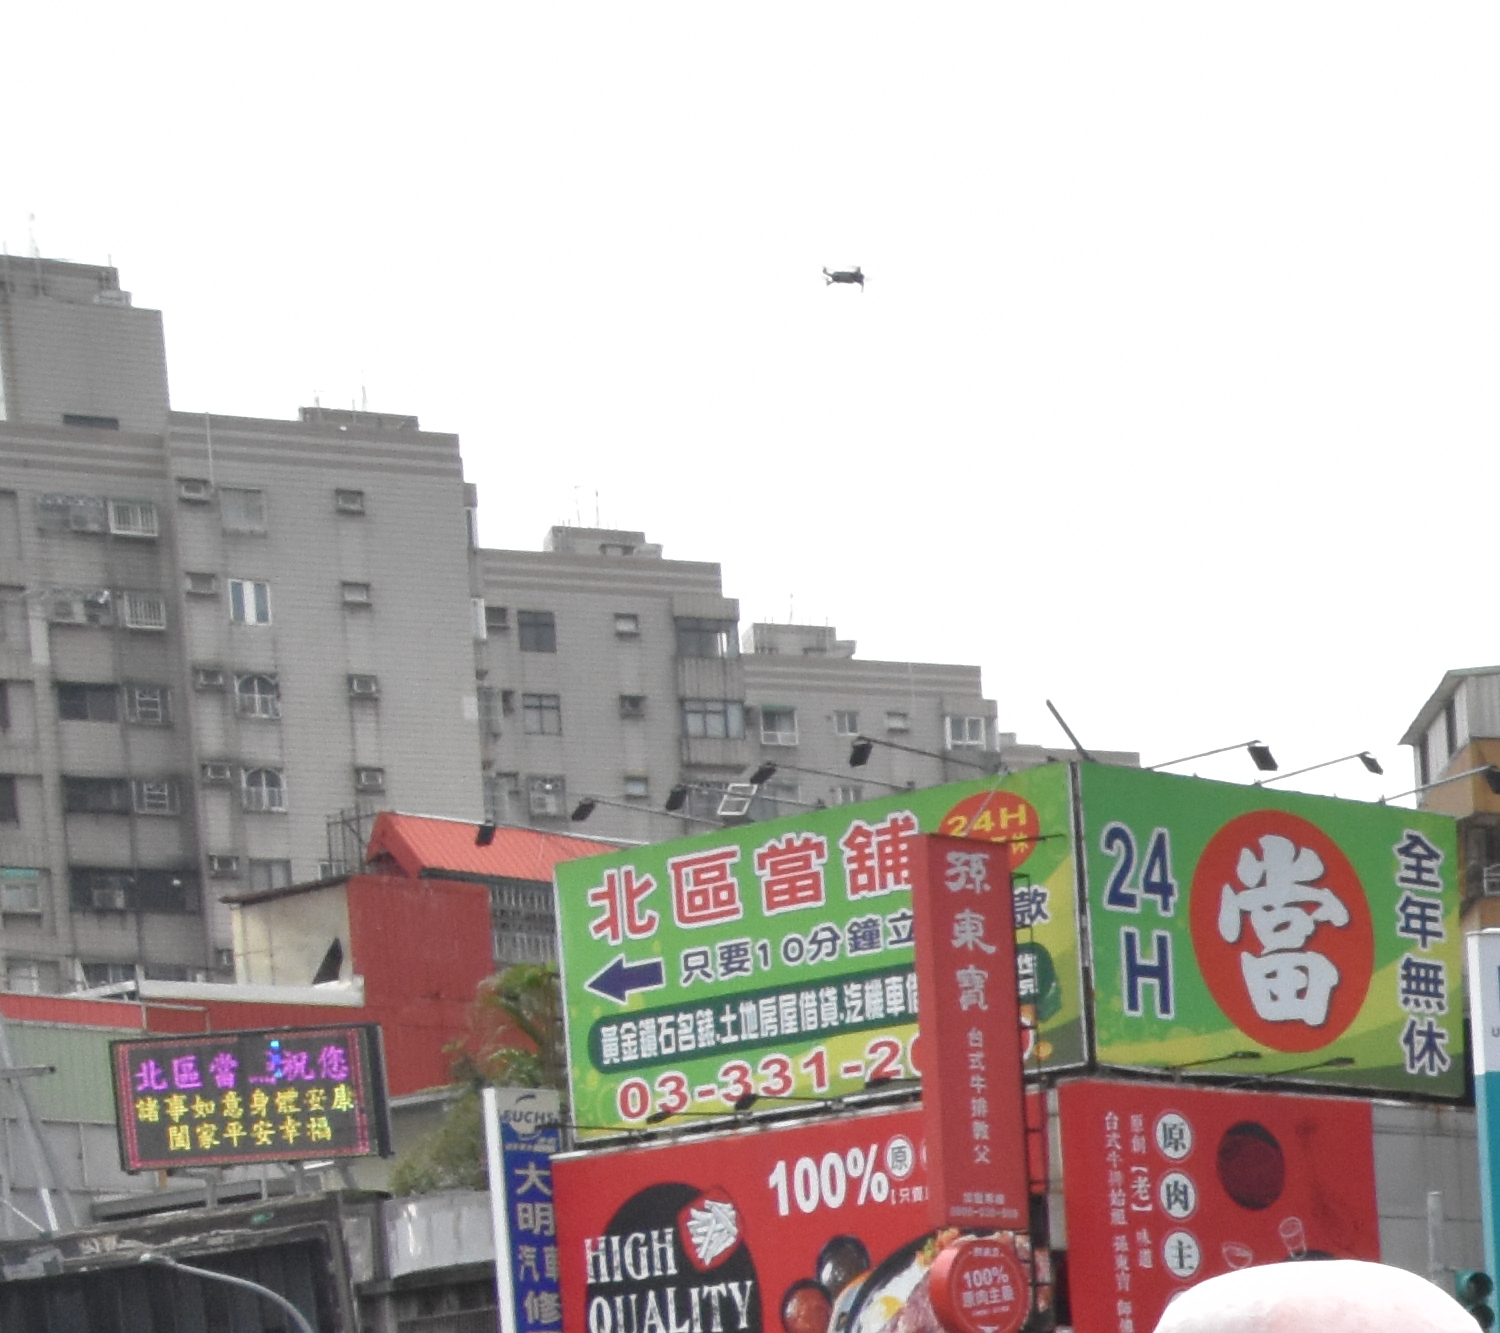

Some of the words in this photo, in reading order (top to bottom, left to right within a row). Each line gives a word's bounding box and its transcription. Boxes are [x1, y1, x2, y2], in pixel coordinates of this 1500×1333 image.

[587, 810, 920, 945] 北區當舖
[1100, 821, 1178, 917] 24
[1120, 926, 1175, 1020] H
[1393, 828, 1451, 1077] 全年無休
[769, 1143, 890, 1217] 100%
[584, 1227, 678, 1285] HIGH
